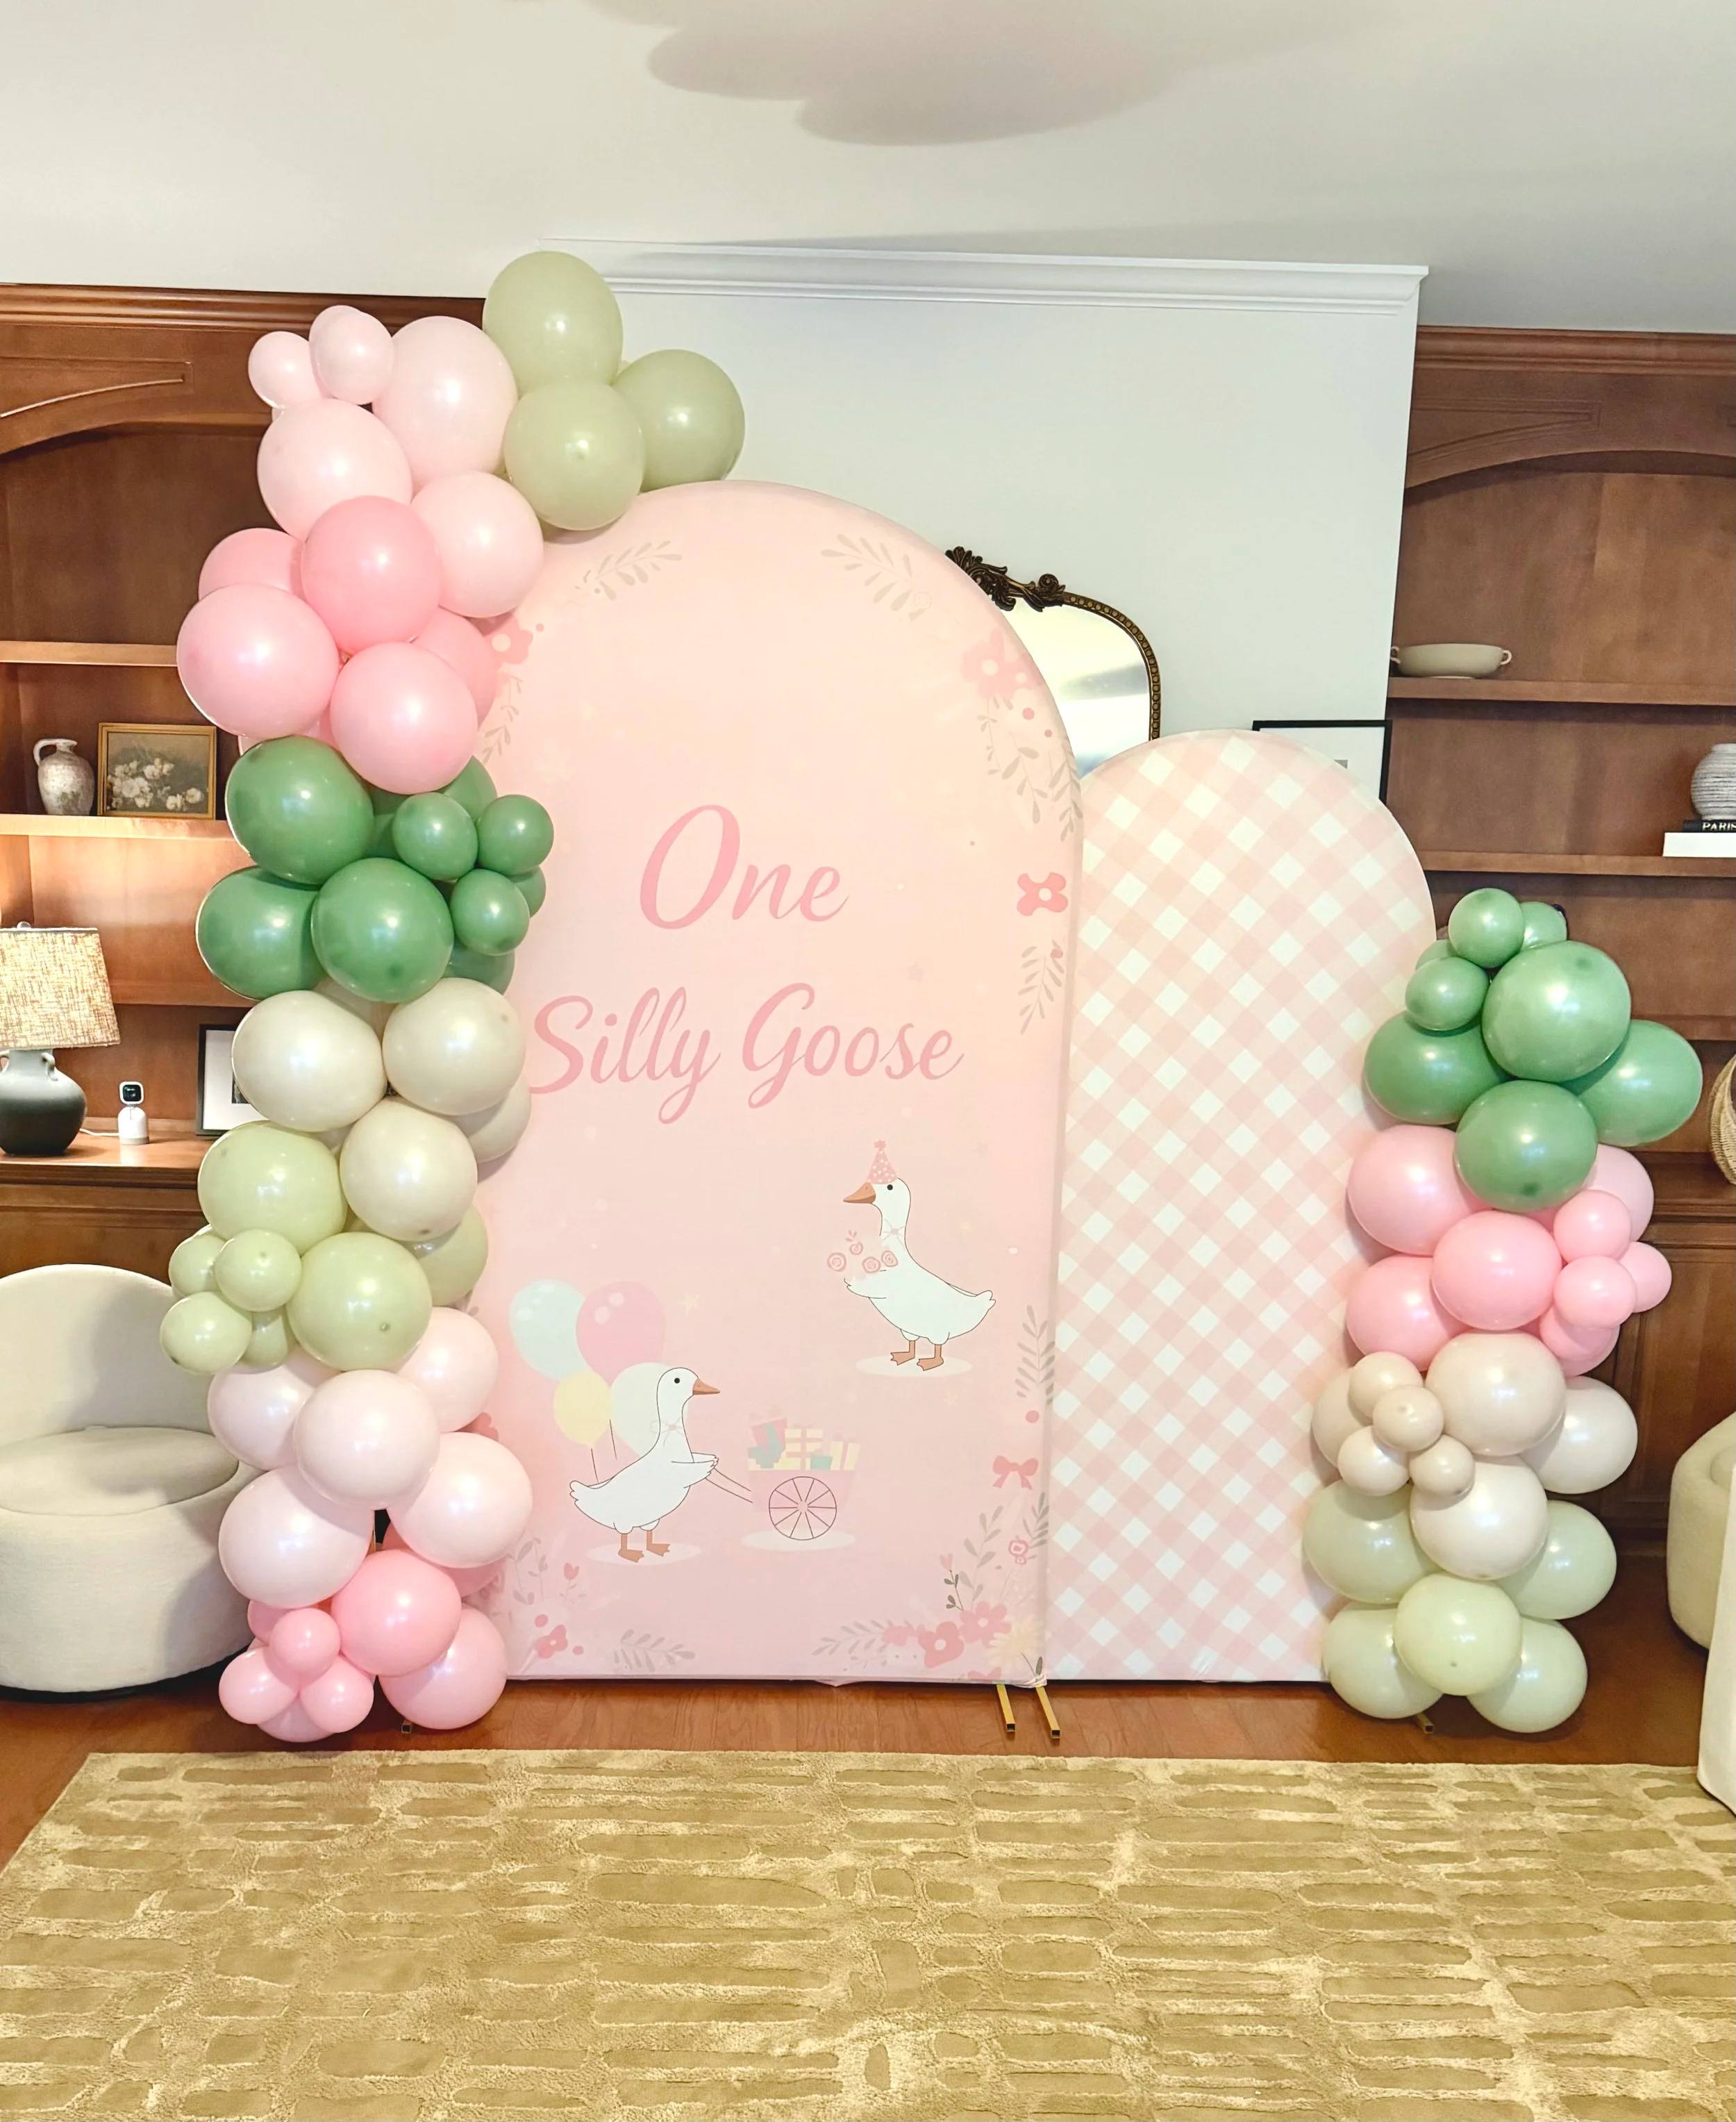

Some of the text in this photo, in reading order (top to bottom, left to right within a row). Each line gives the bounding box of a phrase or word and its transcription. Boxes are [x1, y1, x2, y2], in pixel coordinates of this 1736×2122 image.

[640, 804, 850, 930] One
[529, 982, 965, 1125] Silly Goose
